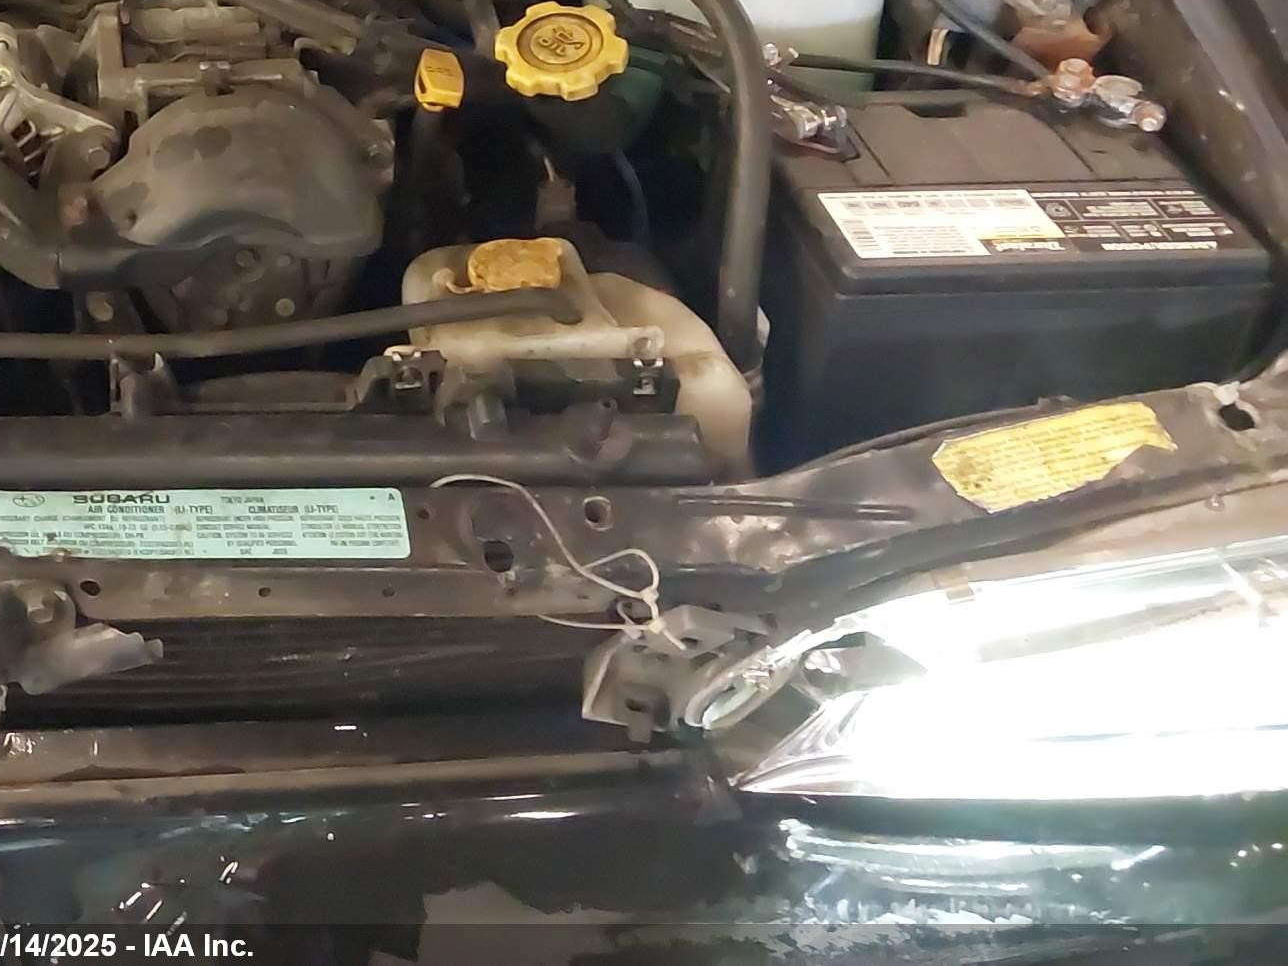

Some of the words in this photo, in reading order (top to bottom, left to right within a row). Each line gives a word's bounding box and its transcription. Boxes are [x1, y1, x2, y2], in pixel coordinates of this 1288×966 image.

[537, 36, 568, 58] OIL
[72, 493, 170, 504] SUBARU
[387, 493, 396, 501] A
[88, 505, 103, 514] AIR
[106, 505, 165, 514] CONDITIONER
